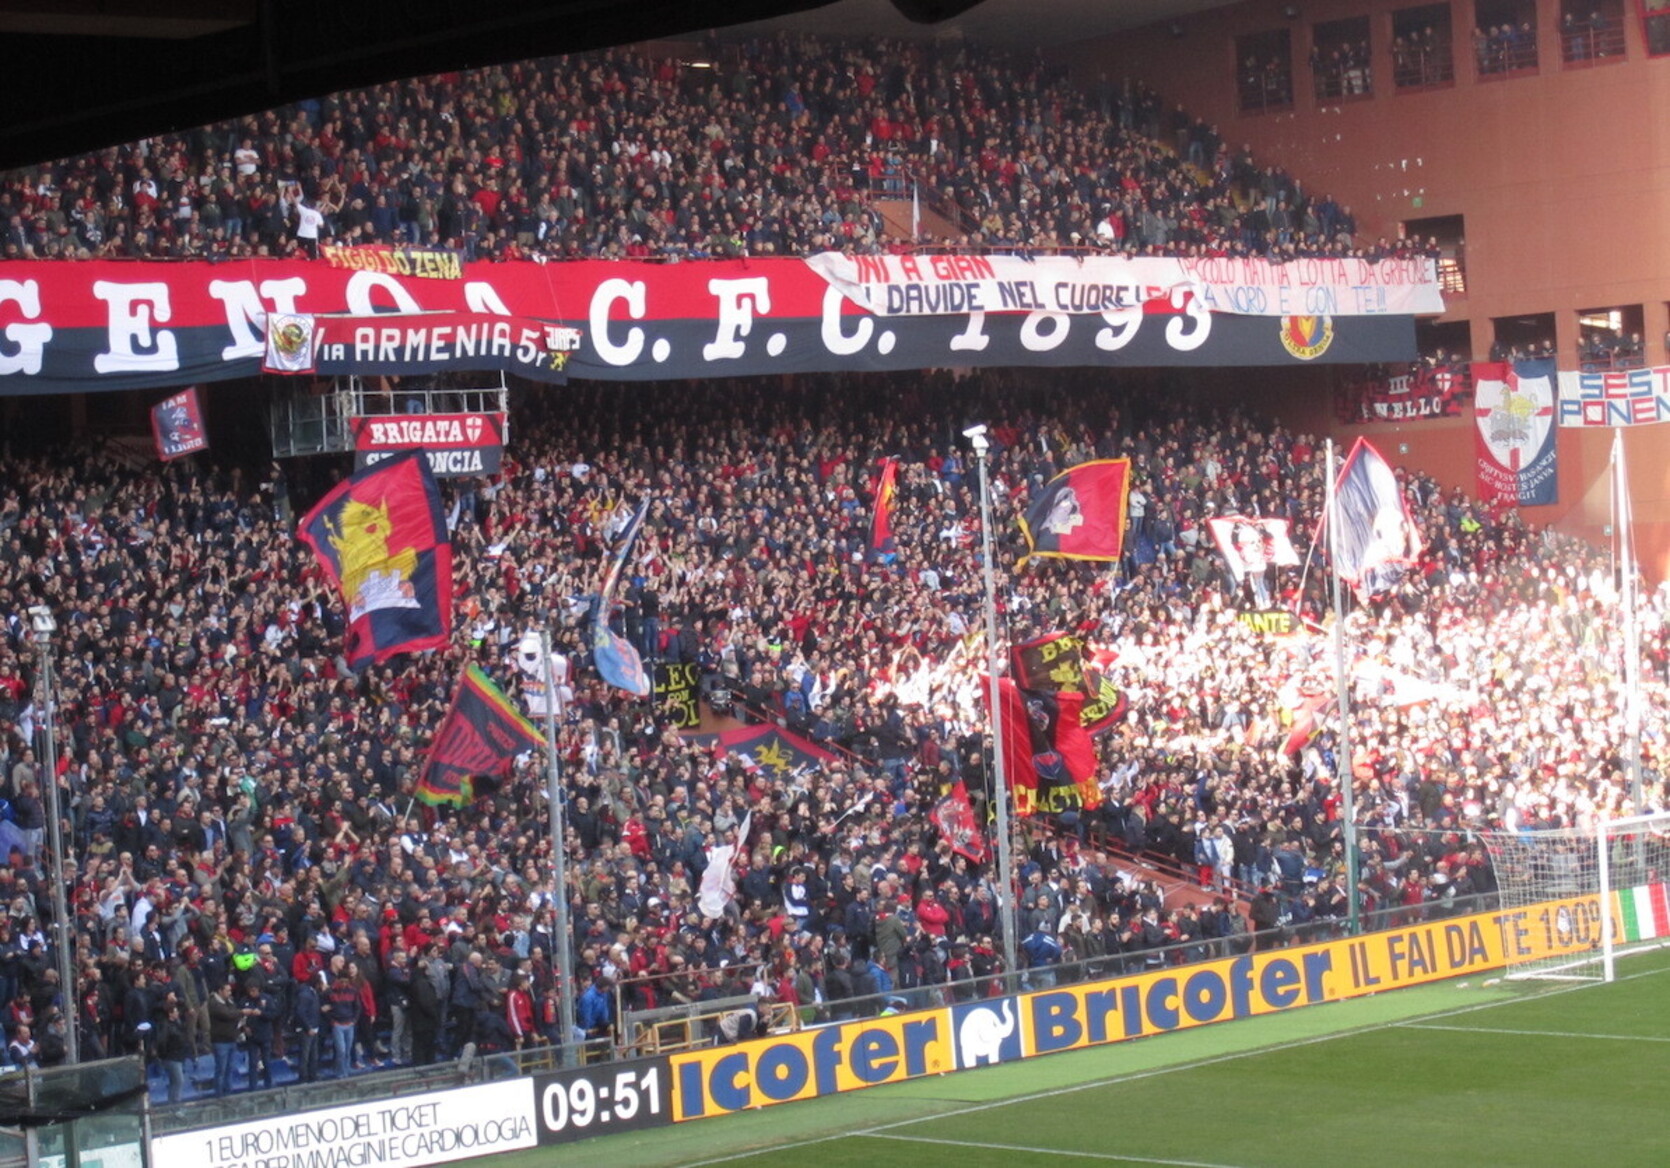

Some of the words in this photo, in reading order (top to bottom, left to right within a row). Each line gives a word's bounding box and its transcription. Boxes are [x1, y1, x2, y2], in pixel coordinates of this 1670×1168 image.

[411, 251, 463, 280] ZENA
[901, 255, 924, 282] A
[930, 254, 996, 281] GIAN
[1297, 257, 1349, 287] LOTTA
[886, 282, 985, 314] DAVIDE
[997, 280, 1047, 310] NEL
[1055, 281, 1131, 312] CUORE
[1306, 286, 1338, 314] CON
[354, 321, 511, 362] ARMENIA
[370, 419, 464, 444] BRIGATA
[1348, 942, 1381, 989] IL
[1387, 928, 1438, 982] FAI
[1445, 919, 1489, 970] DA
[1492, 910, 1532, 958] TE
[541, 1066, 661, 1131] 09:51
[205, 1140, 214, 1163] 1
[218, 1129, 274, 1161] EURO
[276, 1118, 339, 1151] MENO
[340, 1113, 378, 1141] DEL
[377, 1101, 441, 1133] TICKET
[388, 1136, 401, 1160] E
[401, 1115, 532, 1158] CARDIOLOGIA
